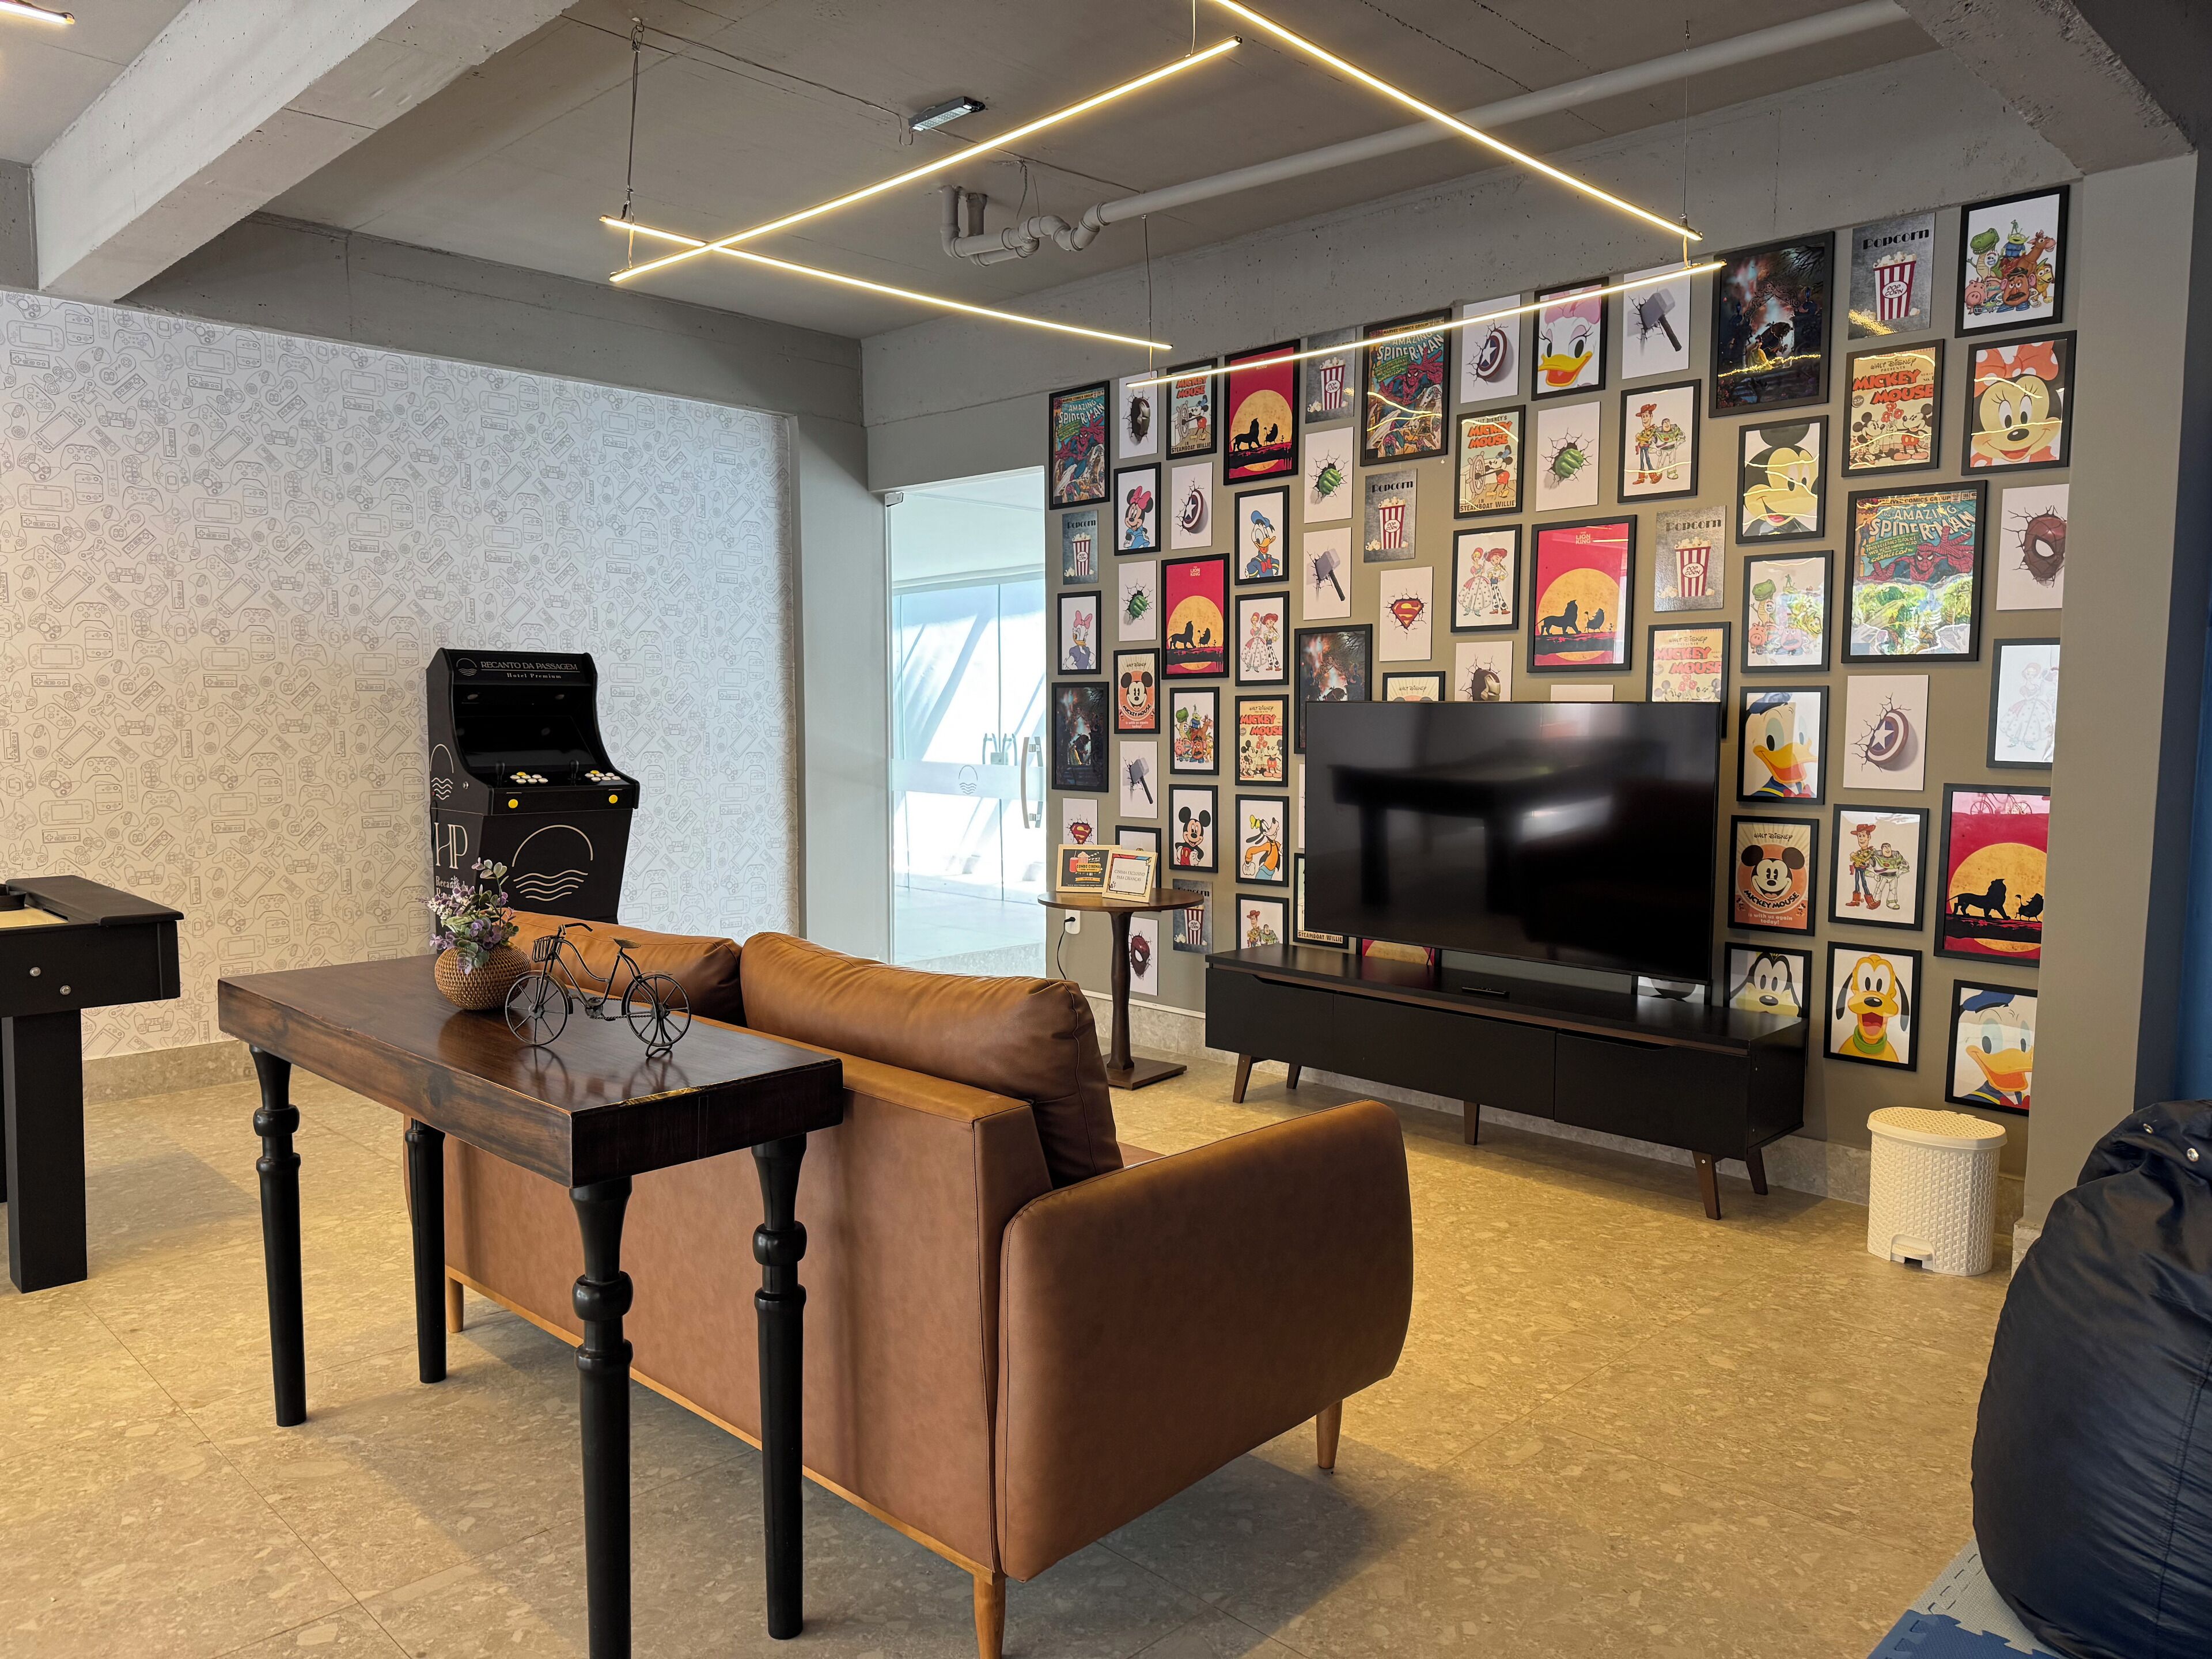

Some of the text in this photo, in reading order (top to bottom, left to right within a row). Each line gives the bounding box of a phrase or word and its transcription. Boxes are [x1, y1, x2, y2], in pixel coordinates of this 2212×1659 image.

[1863, 229, 1929, 250] Popcorn
[1392, 332, 1433, 346] AMAZING
[1888, 358, 1916, 367] DISNEY
[1853, 369, 1922, 392] MICKEY
[1176, 385, 1206, 399] MOUSE
[1870, 384, 1934, 405] MOUSE
[1069, 400, 1097, 412] AMAZING
[1468, 434, 1509, 449] MOUSE
[1172, 444, 1195, 453] STEAMBOAT
[1372, 481, 1413, 493] Popcorn
[1067, 520, 1096, 529] Popcorn
[1666, 519, 1721, 532] Popcorn
[1683, 635, 1708, 643] DISNEY
[1653, 646, 1712, 661] MICKEY
[536, 662, 578, 671] PASSAGEM
[1668, 661, 1722, 675] MOUSE
[1123, 703, 1152, 717] MICKEY MOUSE
[1240, 714, 1277, 725] MICKEY
[1768, 832, 1793, 842] DISNEY
[434, 822, 468, 869] HP
[1744, 889, 1800, 908] MICKEY MOUSE
[1298, 931, 1325, 940] STEAMBOAT
